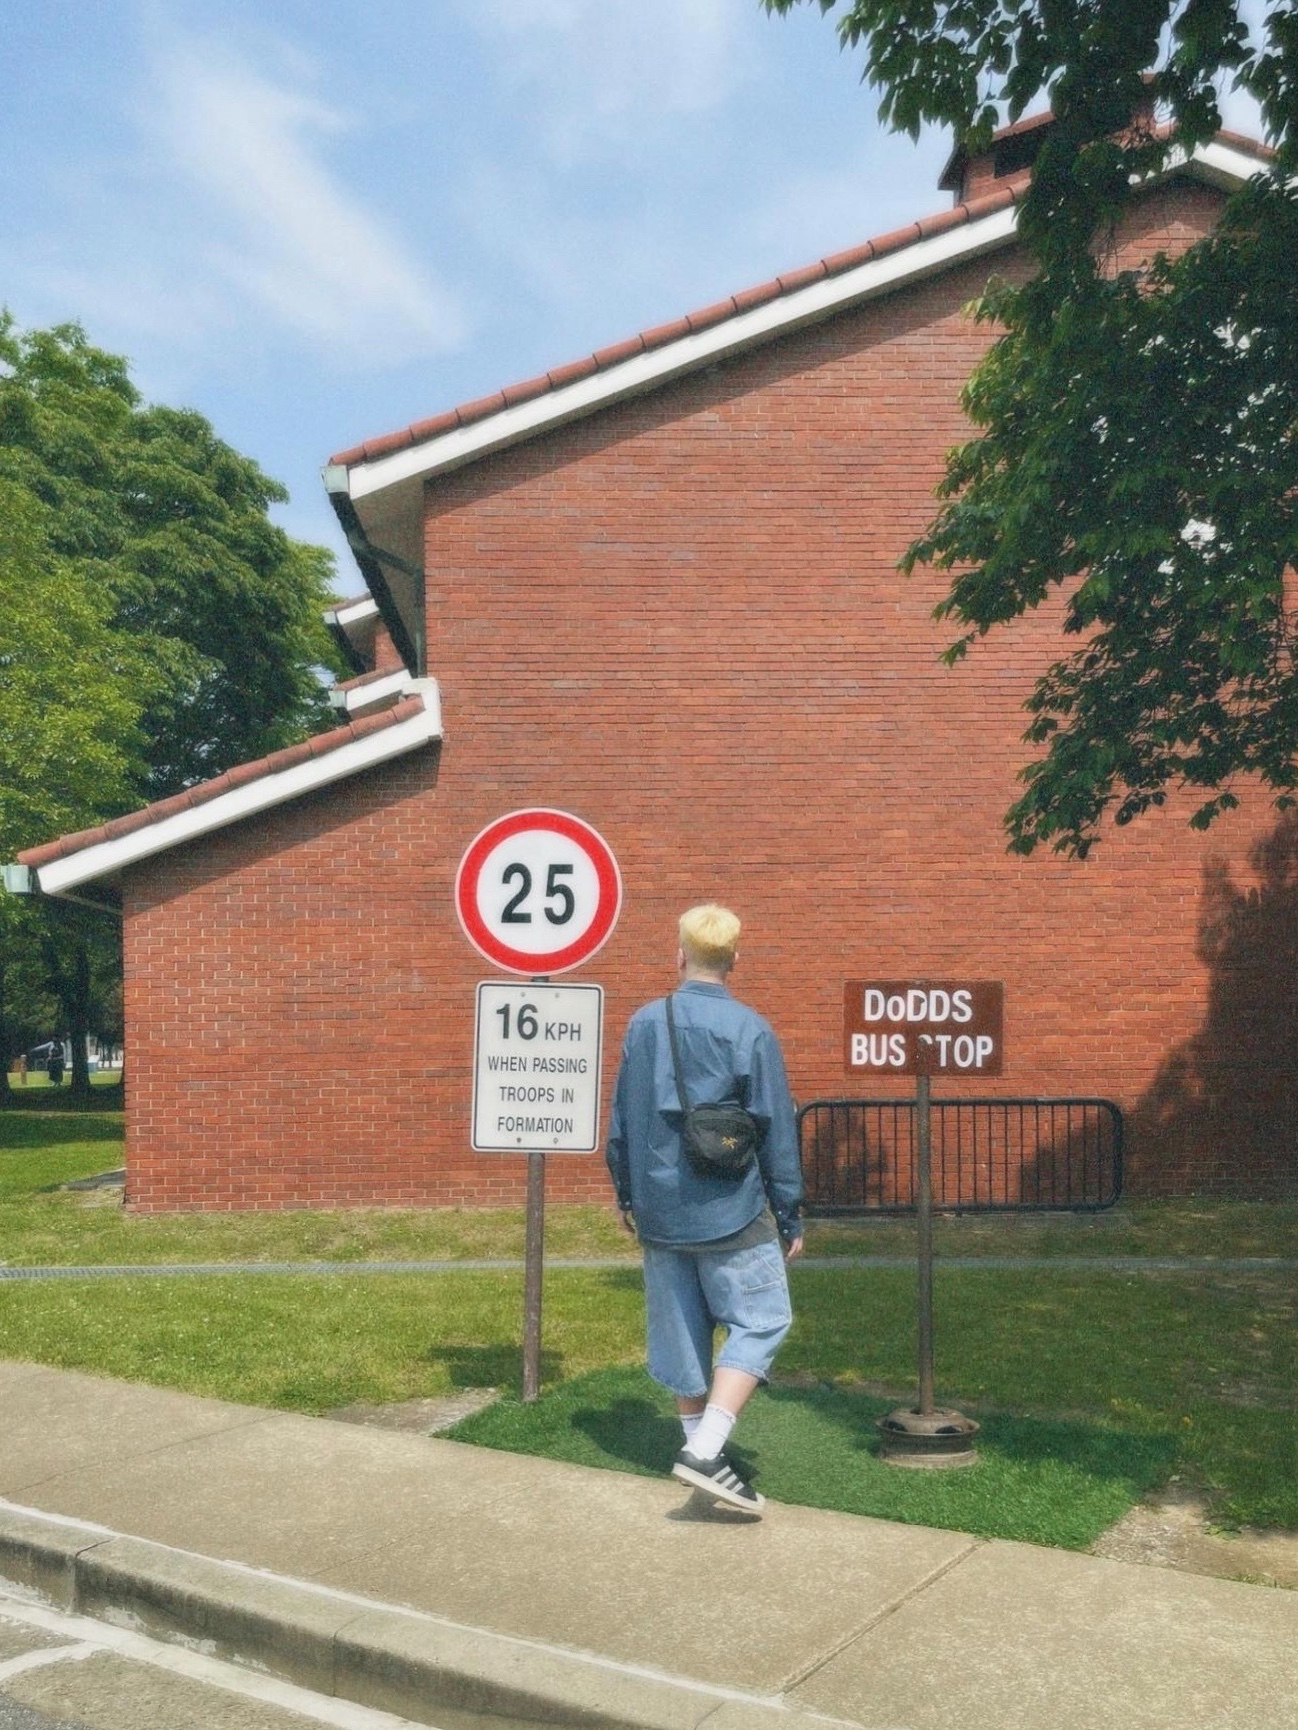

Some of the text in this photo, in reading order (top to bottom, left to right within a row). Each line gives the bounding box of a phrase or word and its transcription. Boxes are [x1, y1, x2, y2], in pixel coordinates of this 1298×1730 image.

[500, 862, 576, 926] 25
[864, 989, 973, 1022] DoDDS
[496, 1003, 582, 1042] 16 KPH
[488, 1056, 588, 1073] WHEN PASSING
[851, 1033, 994, 1068] BUS TOP
[499, 1087, 574, 1104] TROOPS IN
[497, 1116, 574, 1134] FORMATION
